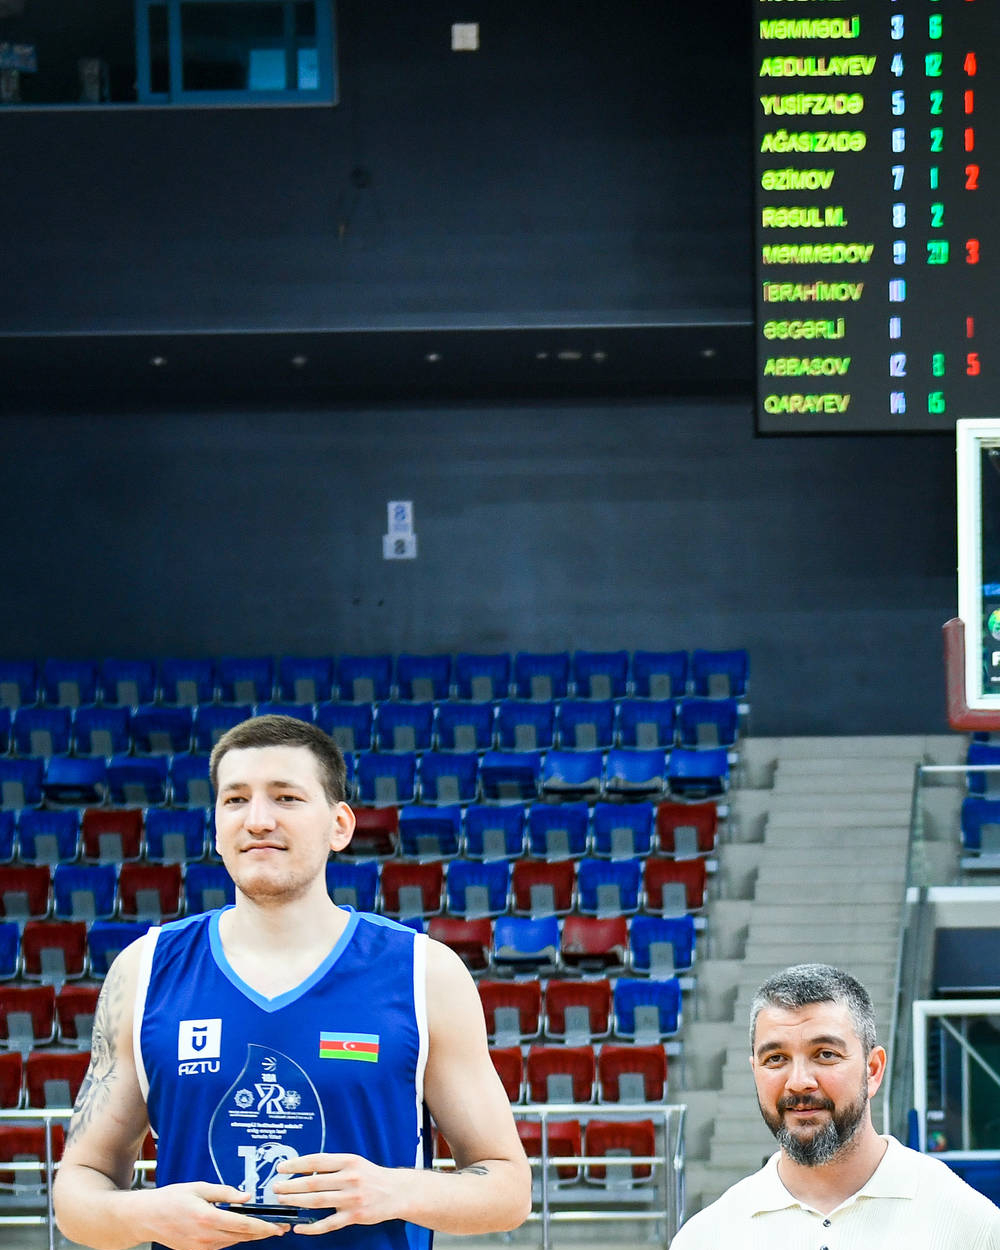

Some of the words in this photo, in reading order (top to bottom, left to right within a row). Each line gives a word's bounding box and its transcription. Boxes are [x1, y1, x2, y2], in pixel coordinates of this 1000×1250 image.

[891, 14, 904, 40] 3
[929, 14, 942, 39] 6
[760, 55, 876, 77] ABDULLAYEV
[891, 53, 904, 77] 4
[925, 52, 942, 76] 12
[964, 52, 977, 76] 4
[892, 90, 905, 115] 5
[930, 90, 943, 114] 2
[964, 90, 974, 114] 1
[892, 128, 905, 152] 6
[931, 127, 943, 152] 2
[964, 128, 974, 152] 1
[892, 165, 904, 190] 7
[930, 167, 938, 189] 1
[965, 164, 979, 190] 2
[931, 203, 944, 227] 2
[893, 240, 906, 265] 9
[927, 240, 949, 264] 20
[966, 239, 979, 264] 3
[967, 317, 974, 338] 1
[966, 352, 980, 376] 5
[178, 1061, 220, 1076] AZTU
